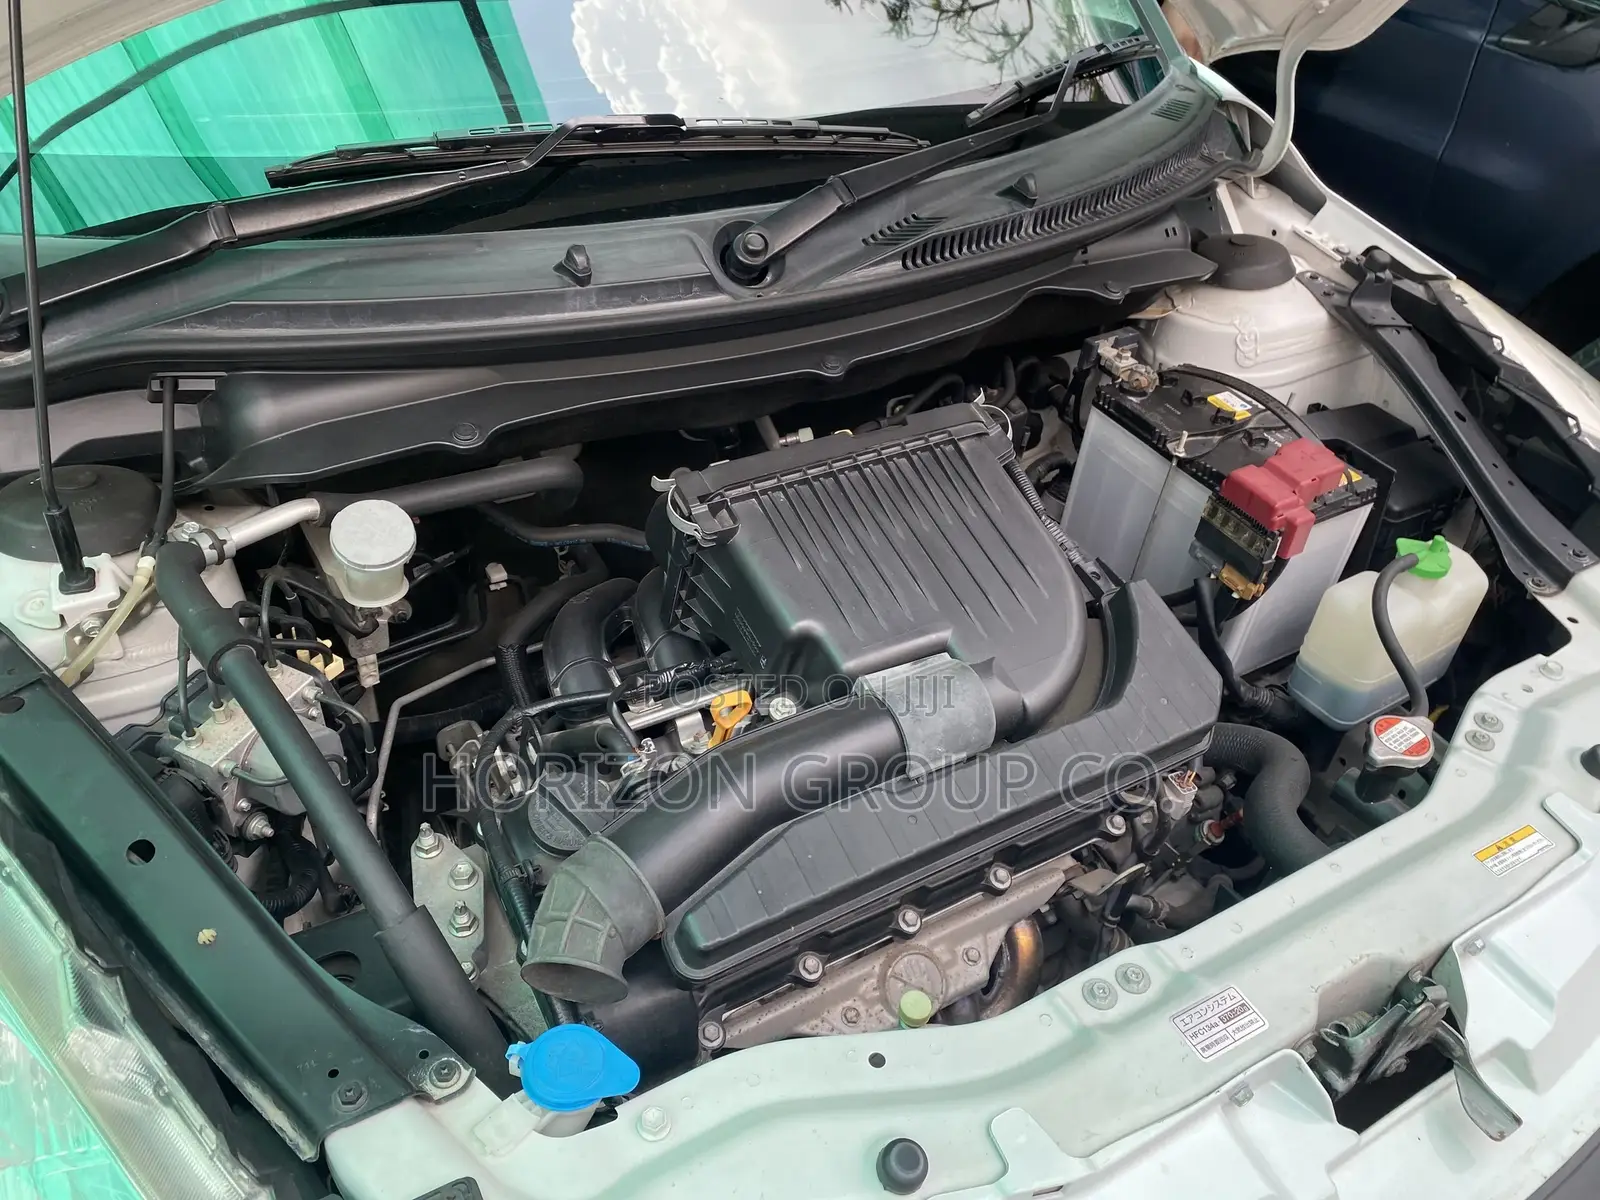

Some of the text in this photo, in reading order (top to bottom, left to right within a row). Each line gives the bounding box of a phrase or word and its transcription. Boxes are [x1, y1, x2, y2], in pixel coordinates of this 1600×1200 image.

[1180, 993, 1236, 1027] エアコンシステム
